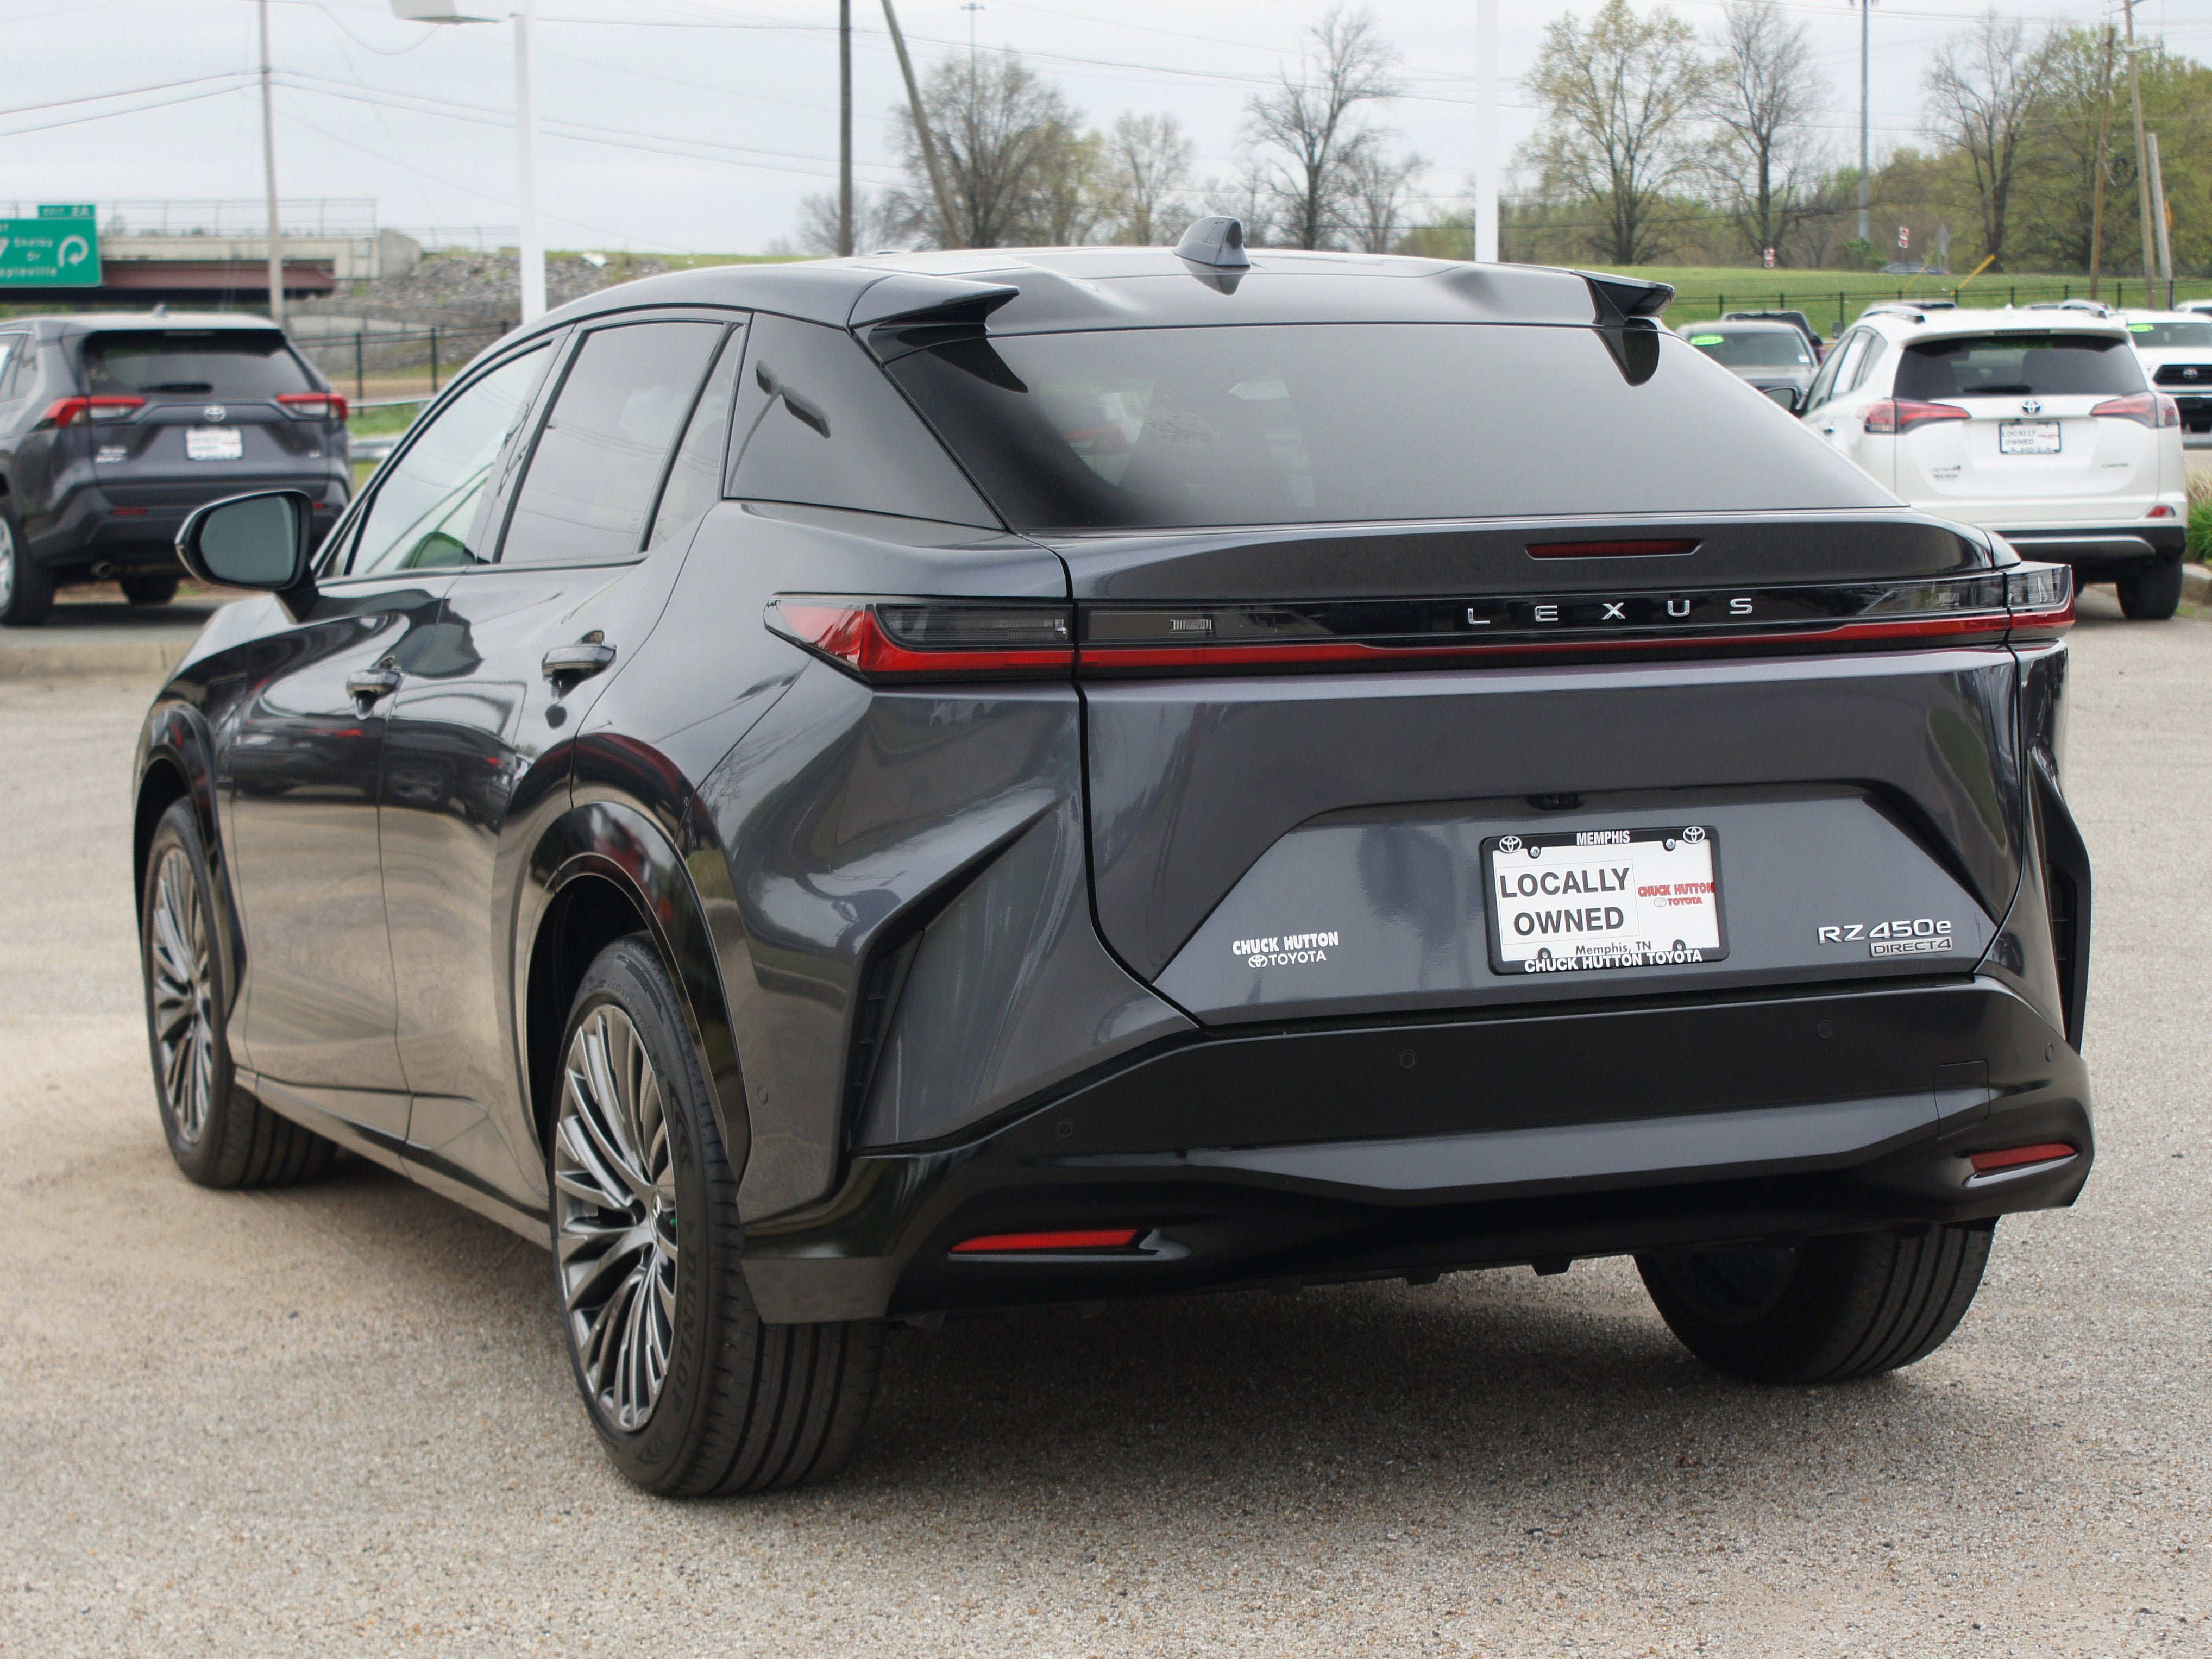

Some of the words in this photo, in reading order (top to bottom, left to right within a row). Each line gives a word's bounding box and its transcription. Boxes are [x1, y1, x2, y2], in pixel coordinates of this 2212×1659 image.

[1467, 598, 1753, 625] LEXUS
[1576, 830, 1630, 846] MEMPHIS
[1499, 867, 1630, 898] LOCALLY
[1638, 884, 1671, 897] CHUCK
[1674, 882, 1715, 895] HUTTON
[1667, 896, 1703, 906] TOYOTA
[1513, 906, 1624, 936] OWNED
[1232, 937, 1279, 955] CHUCK
[1283, 931, 1339, 951] HUTTON
[1576, 942, 1631, 957] Memphis,
[1636, 941, 1651, 951] TN
[1874, 938, 1951, 954] DIRECT4
[1268, 950, 1327, 966] TOYOTA
[1524, 956, 1578, 973] CHUCK
[1582, 953, 1643, 969] HUTTON
[1648, 950, 1702, 965] TOYOTA
